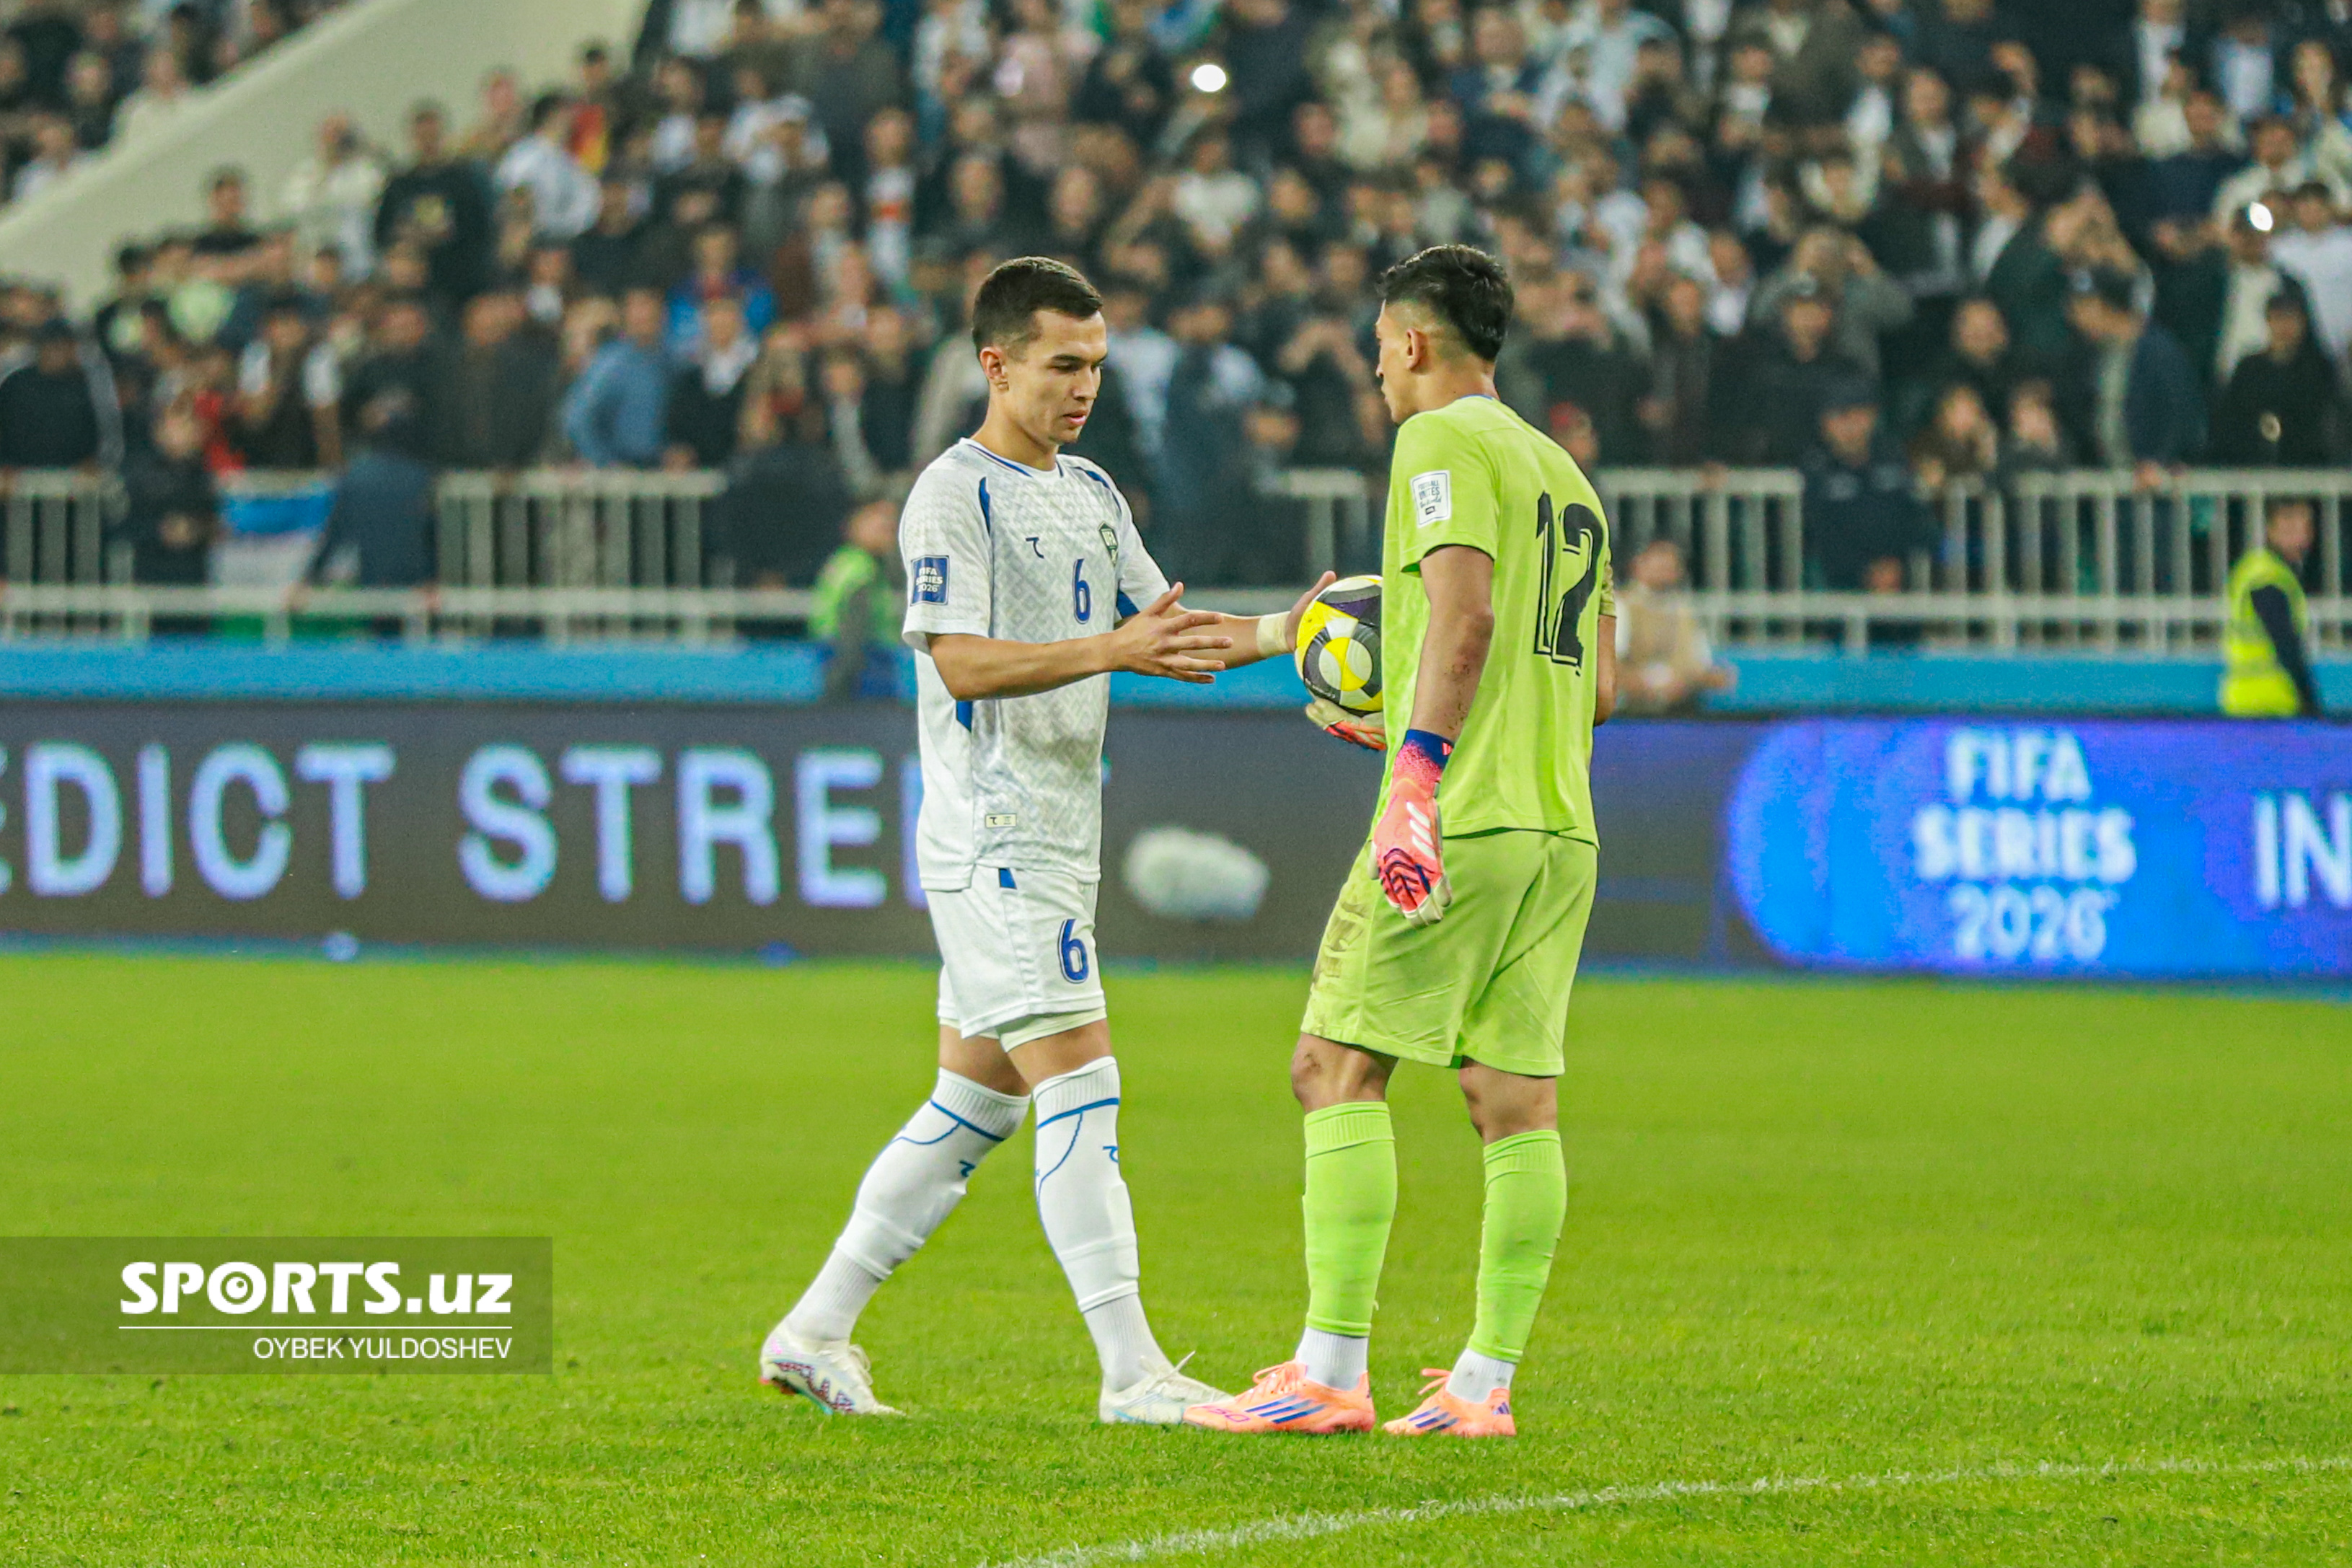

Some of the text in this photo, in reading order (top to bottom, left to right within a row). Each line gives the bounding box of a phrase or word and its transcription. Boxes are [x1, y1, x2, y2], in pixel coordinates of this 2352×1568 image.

[919, 567, 937, 576] FIFA
[1073, 558, 1091, 624] 6
[1534, 490, 1603, 670] 12
[1949, 728, 2090, 802] FIFA
[0, 740, 1111, 909] DICT STRE
[1913, 803, 2137, 884] SERIES
[1058, 918, 1089, 984] 6
[1949, 883, 2107, 961] 2026
